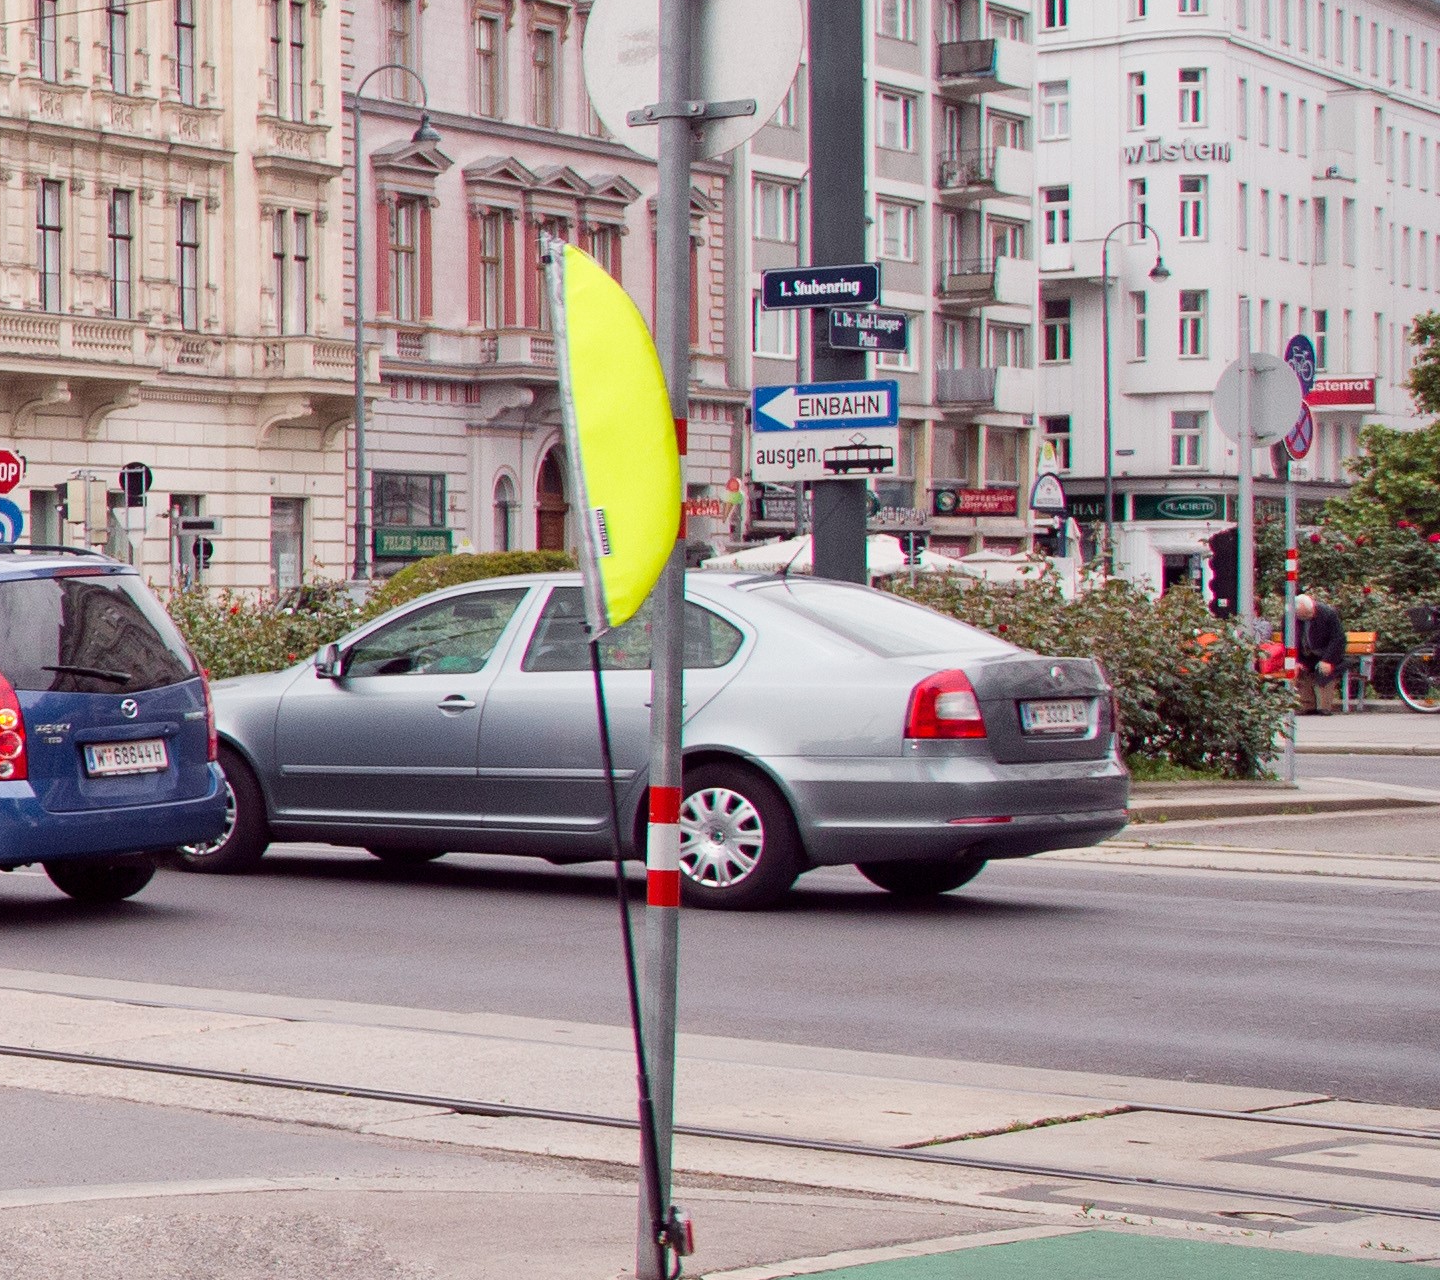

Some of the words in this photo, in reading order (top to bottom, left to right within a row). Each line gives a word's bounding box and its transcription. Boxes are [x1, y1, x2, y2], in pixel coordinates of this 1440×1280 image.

[779, 280, 792, 297] 1.
[793, 277, 861, 297] Stubenring
[798, 395, 880, 418] EINBAHN
[756, 446, 822, 470] ausgen.
[94, 747, 106, 767] W
